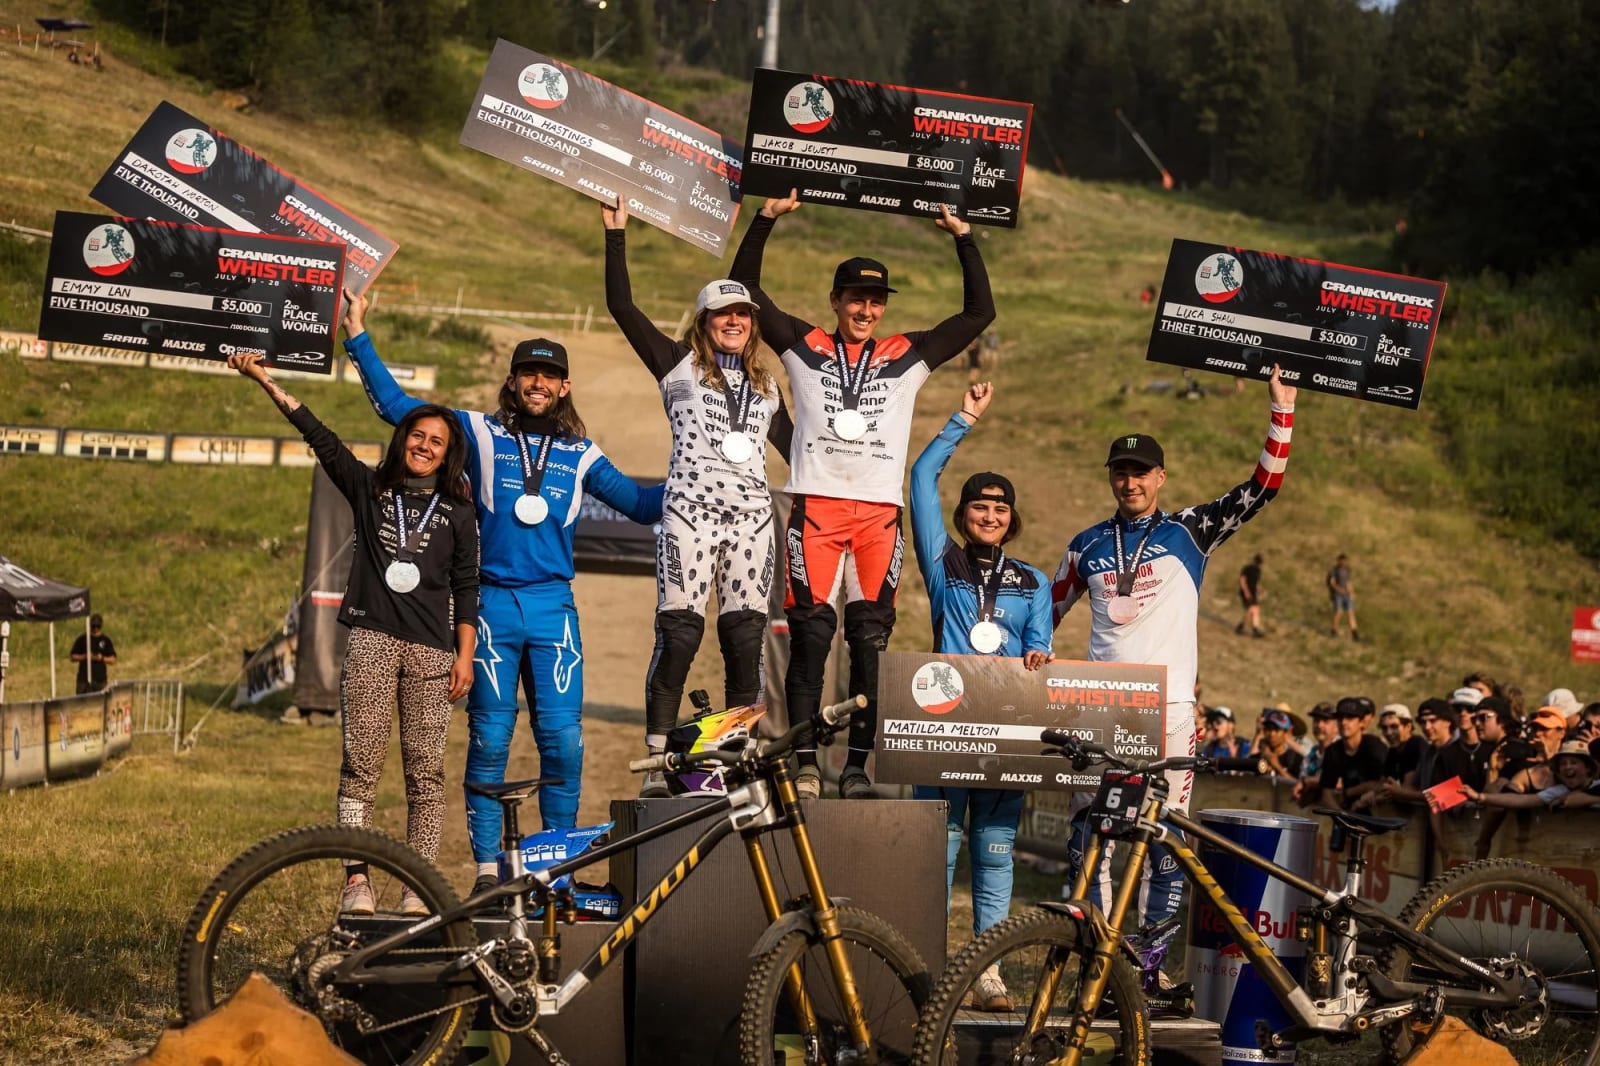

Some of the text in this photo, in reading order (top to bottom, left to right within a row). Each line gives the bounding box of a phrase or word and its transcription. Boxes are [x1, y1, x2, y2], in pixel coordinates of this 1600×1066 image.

[493, 102, 593, 148] JENNA HASTINGS
[913, 106, 1023, 129] CRANKWORX
[477, 110, 581, 157] EIGHT THOUSAND
[913, 116, 1022, 144] WHISTLER
[637, 137, 657, 149] JULY
[644, 117, 743, 170] CRANKWORX
[761, 139, 838, 157] JAKOB JEWETT
[910, 131, 931, 140] JULY
[999, 143, 1020, 151] 2024
[642, 123, 743, 184] WHISTLER
[750, 151, 857, 175] EIGHT THOUSAND
[916, 156, 954, 171] $8,000
[131, 159, 180, 189] DAKOTAH
[638, 160, 675, 184] $8,000
[973, 166, 1006, 178] PLACE
[114, 165, 200, 219] FIVE THOUSAND
[577, 177, 618, 200] MAXXIS
[971, 177, 996, 188] MEN
[691, 188, 722, 209] PLACE
[860, 194, 901, 207] MAXXIS
[689, 197, 729, 223] WOMEN
[278, 201, 377, 273] WHISTER
[284, 194, 384, 262] CRANKWORX
[270, 213, 291, 227] JULY
[348, 263, 369, 278] 2024
[218, 247, 337, 271] CRANKWORX
[217, 257, 337, 287] WHISTLER
[61, 281, 131, 298] EMMY LAN
[214, 273, 237, 281] JULY
[311, 285, 334, 293] 2024
[1321, 280, 1435, 309] CRANKWORX
[50, 296, 150, 317] FIVE THOUSAND
[221, 298, 262, 314] $5,000
[282, 309, 319, 322] PLACE
[1176, 306, 1205, 320] LUCA
[1320, 289, 1433, 323] WHISTLER
[281, 320, 329, 335] WOMEN
[1315, 305, 1337, 314] JULY
[1406, 320, 1429, 330] 2024
[243, 325, 269, 334] DOLLARS
[1161, 320, 1262, 346] THREE THOUSAND
[1319, 330, 1358, 347] $3,000
[162, 338, 206, 352] MAXXIS
[1376, 343, 1412, 358] PLACE
[1337, 356, 1363, 367] DOLLARS
[1374, 354, 1400, 367] MEN
[1329, 376, 1358, 386] OUTDOOR
[1046, 677, 1160, 692] CRANKWORX
[1046, 688, 1160, 708] WHISTLER
[888, 721, 1000, 737] MATILDA MELTON
[1114, 734, 1147, 744] PLACE
[884, 738, 997, 753] THREE THOUSAND
[1114, 744, 1158, 756] WOMEN
[1000, 773, 1043, 783] MAXXIS
[1105, 787, 1123, 809] 6
[585, 898, 619, 907] GoPro
[600, 845, 699, 967] PIVOT
[1199, 903, 1300, 939] Re Bul
